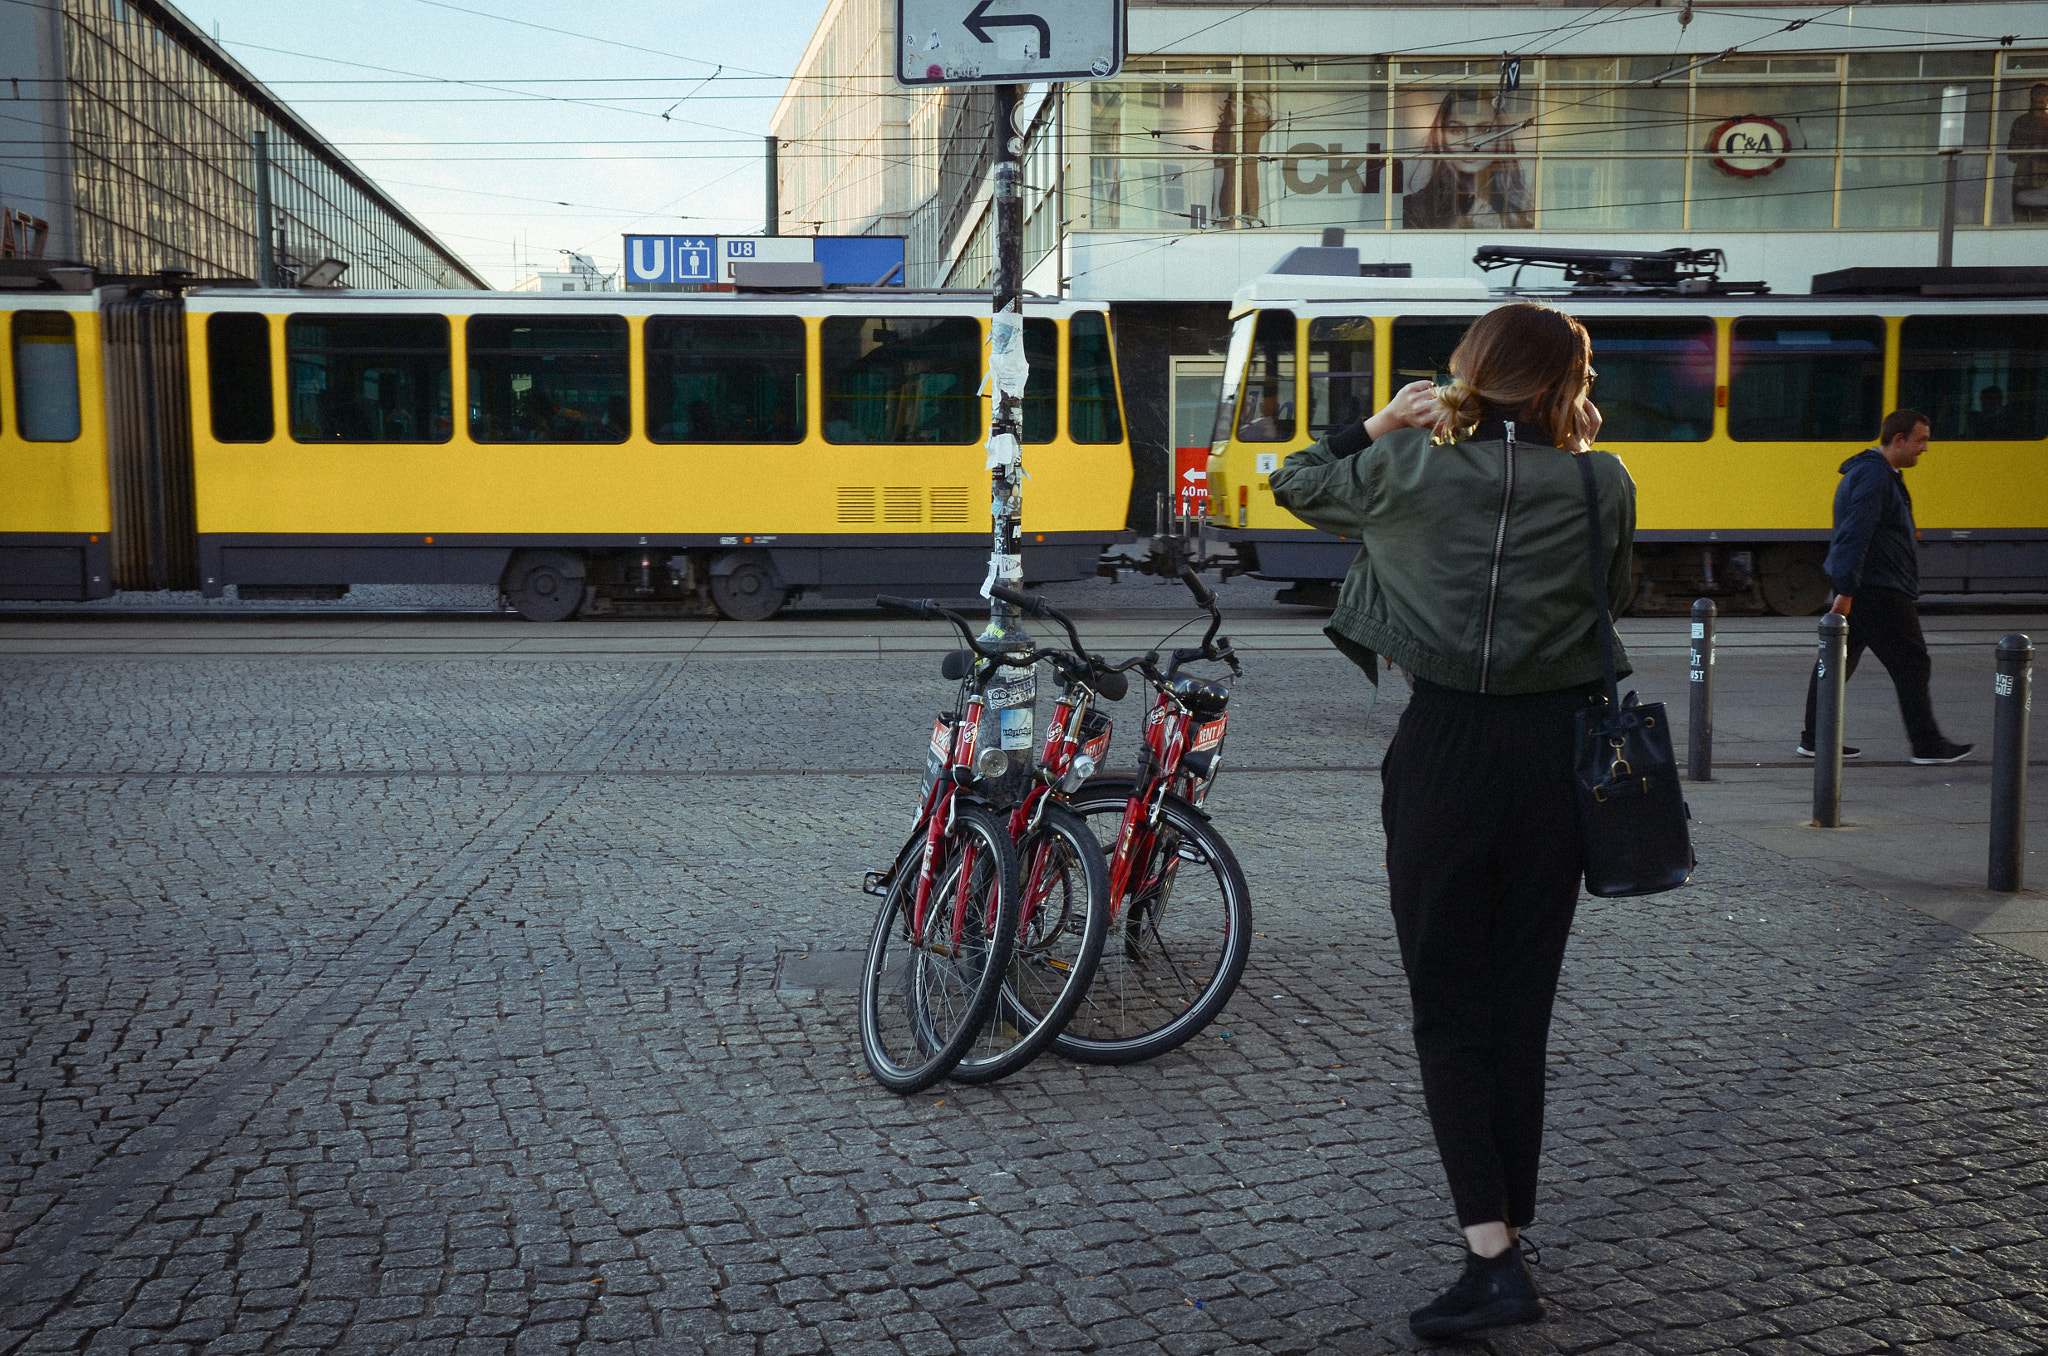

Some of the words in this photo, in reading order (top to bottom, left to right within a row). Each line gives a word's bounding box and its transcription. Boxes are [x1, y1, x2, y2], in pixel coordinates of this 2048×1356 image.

[1726, 133, 1774, 154] C&A
[730, 242, 753, 256] U8
[633, 240, 664, 280] U
[1199, 726, 1217, 744] RENT
